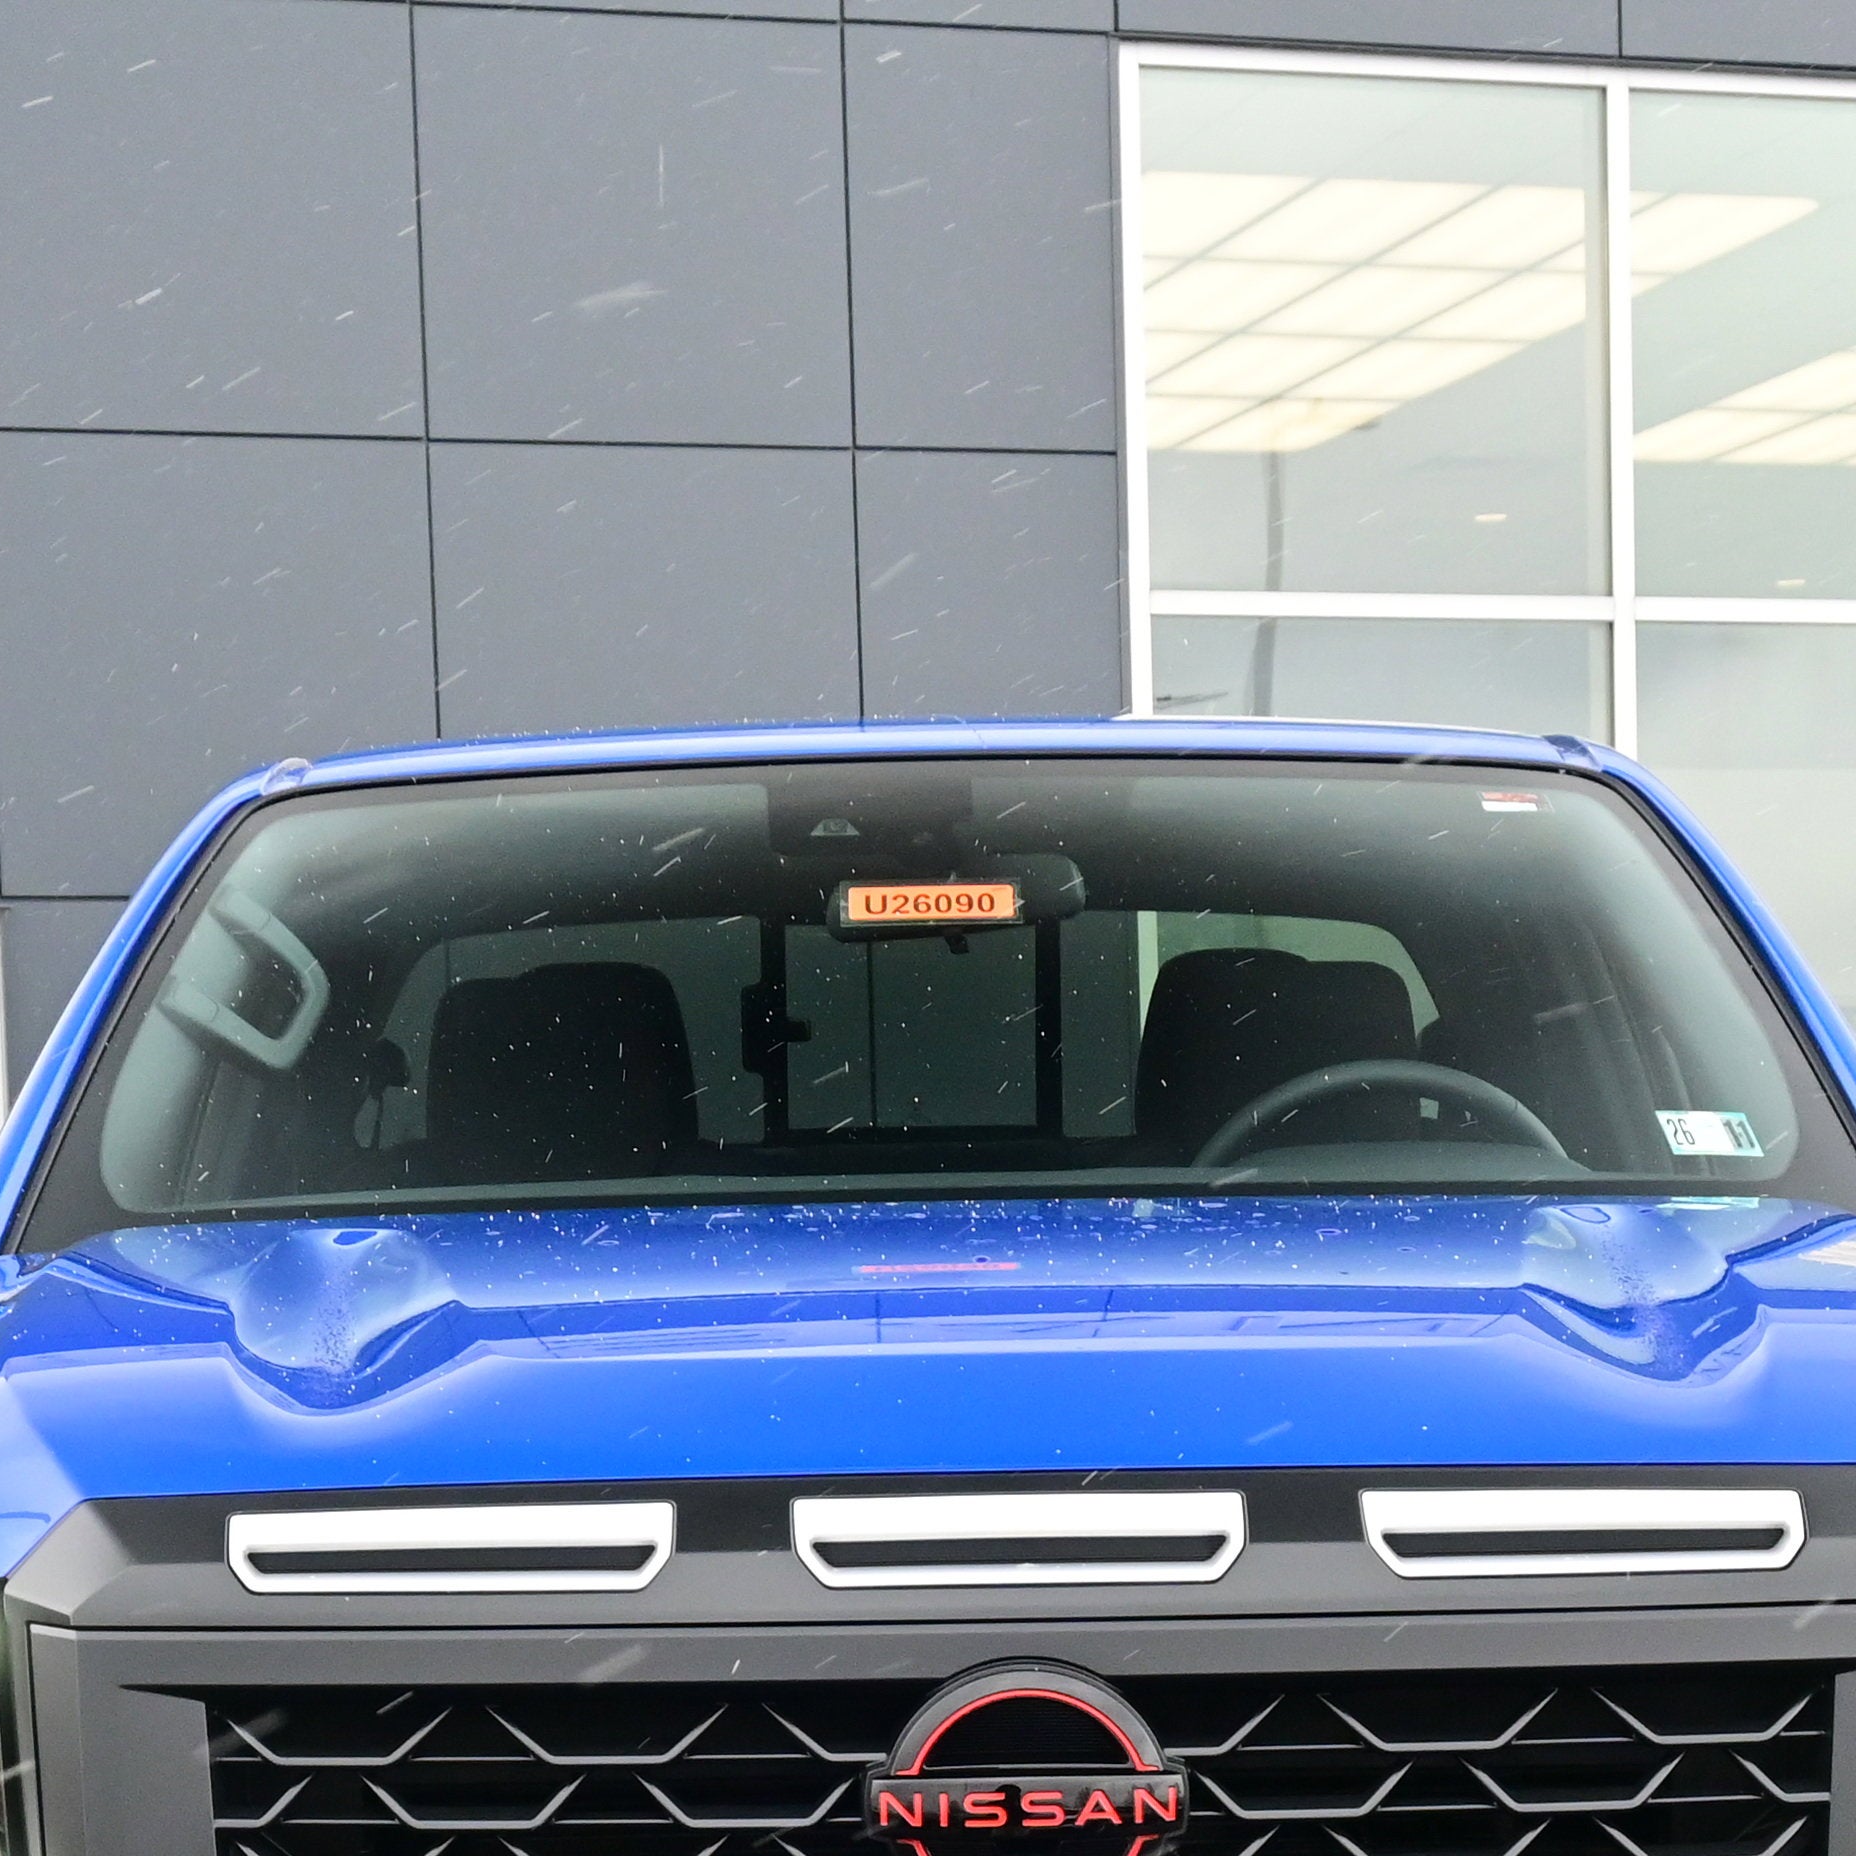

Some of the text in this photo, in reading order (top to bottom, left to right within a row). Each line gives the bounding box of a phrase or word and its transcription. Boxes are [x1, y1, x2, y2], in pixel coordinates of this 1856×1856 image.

[864, 892, 996, 915] U26090
[1665, 1117, 1696, 1146] 26
[877, 1785, 1179, 1829] NISSAN
